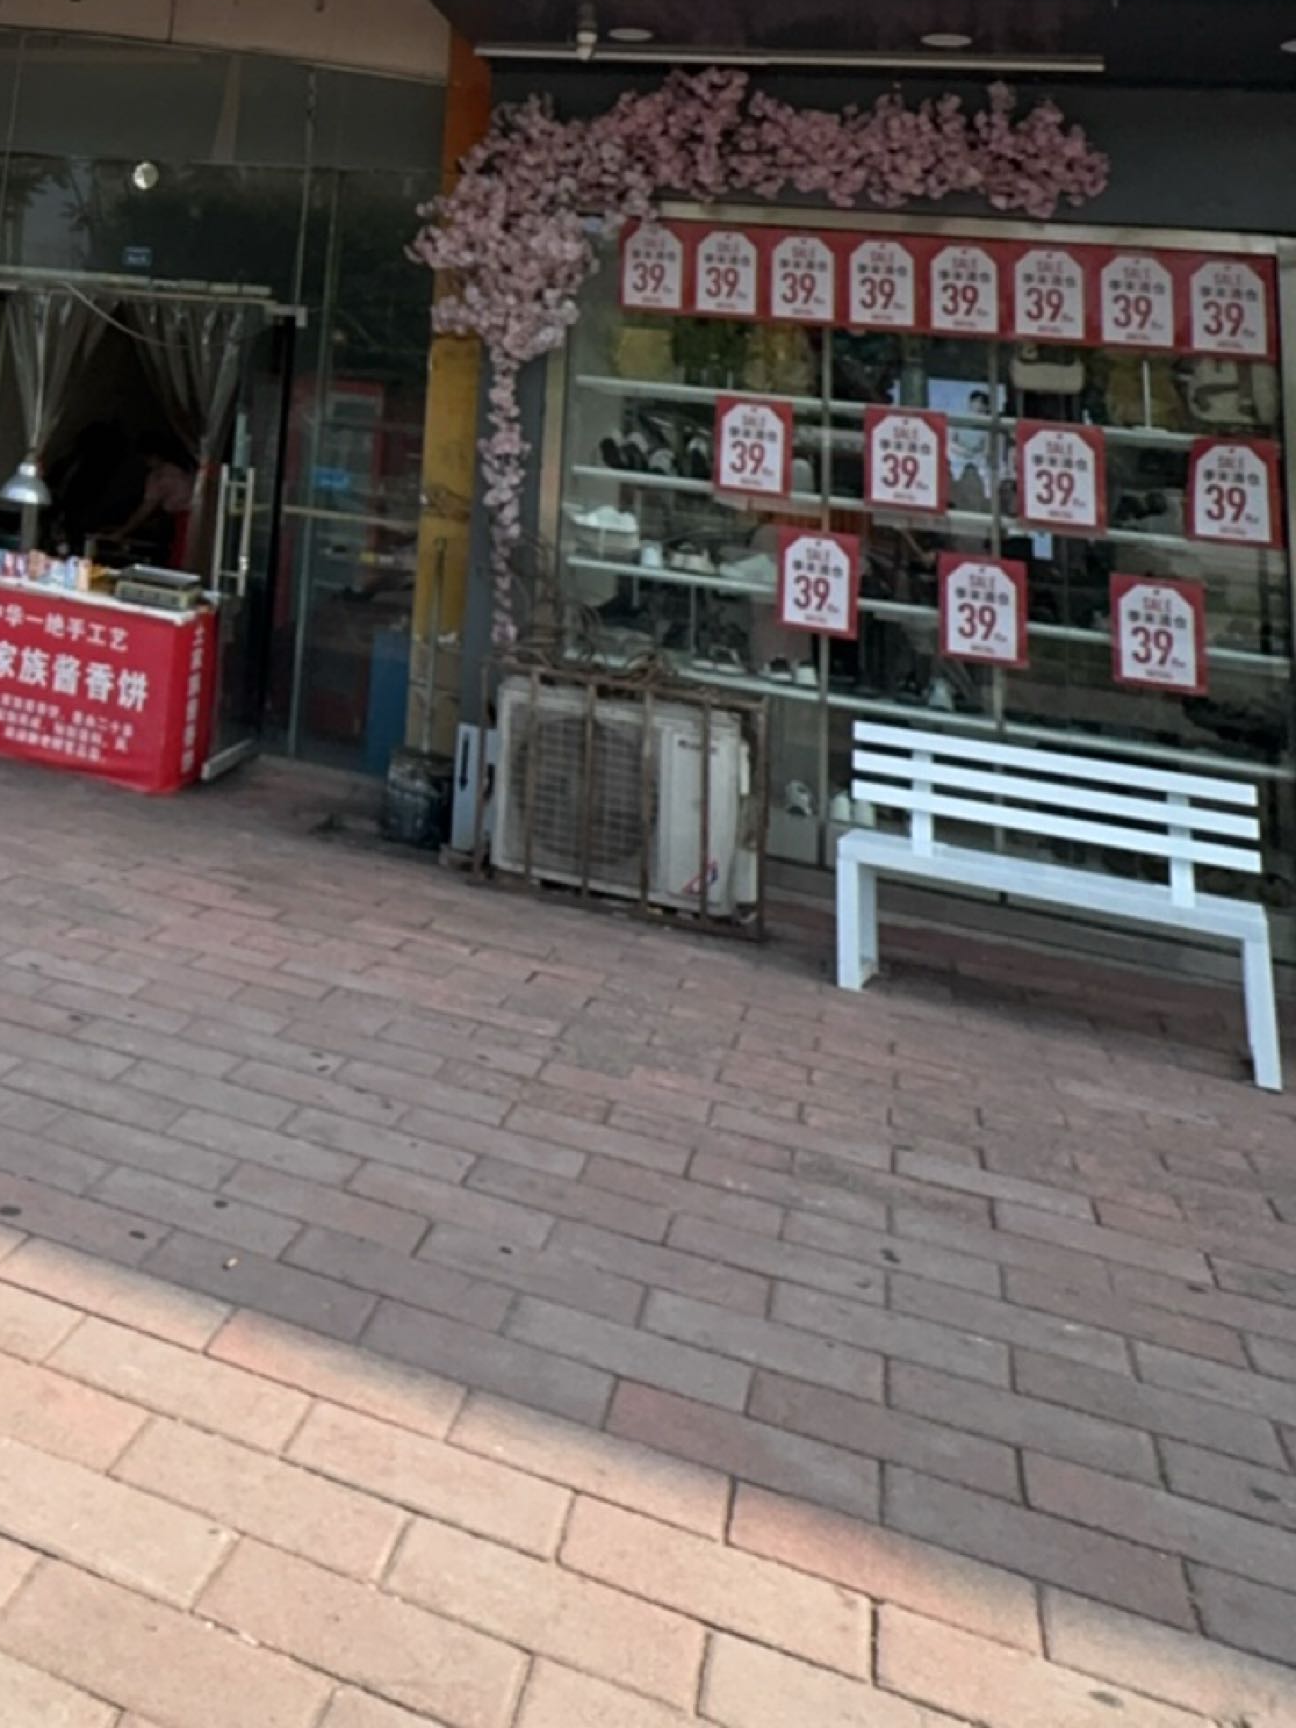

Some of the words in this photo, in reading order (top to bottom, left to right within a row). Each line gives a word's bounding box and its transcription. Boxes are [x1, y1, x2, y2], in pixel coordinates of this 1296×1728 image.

[632, 262, 665, 294] 39
[705, 266, 740, 299] 39
[781, 272, 816, 305] 39
[859, 277, 896, 311] 39
[941, 282, 979, 318] 39
[1025, 286, 1065, 322] 39
[1112, 294, 1153, 330] 39
[1203, 300, 1245, 337] 39
[729, 440, 766, 475] 39
[880, 453, 920, 489] 39
[1034, 469, 1075, 507] 39
[1205, 483, 1247, 521] 39
[792, 575, 831, 611] 39
[957, 603, 997, 641] 39
[1130, 626, 1174, 665] 39
